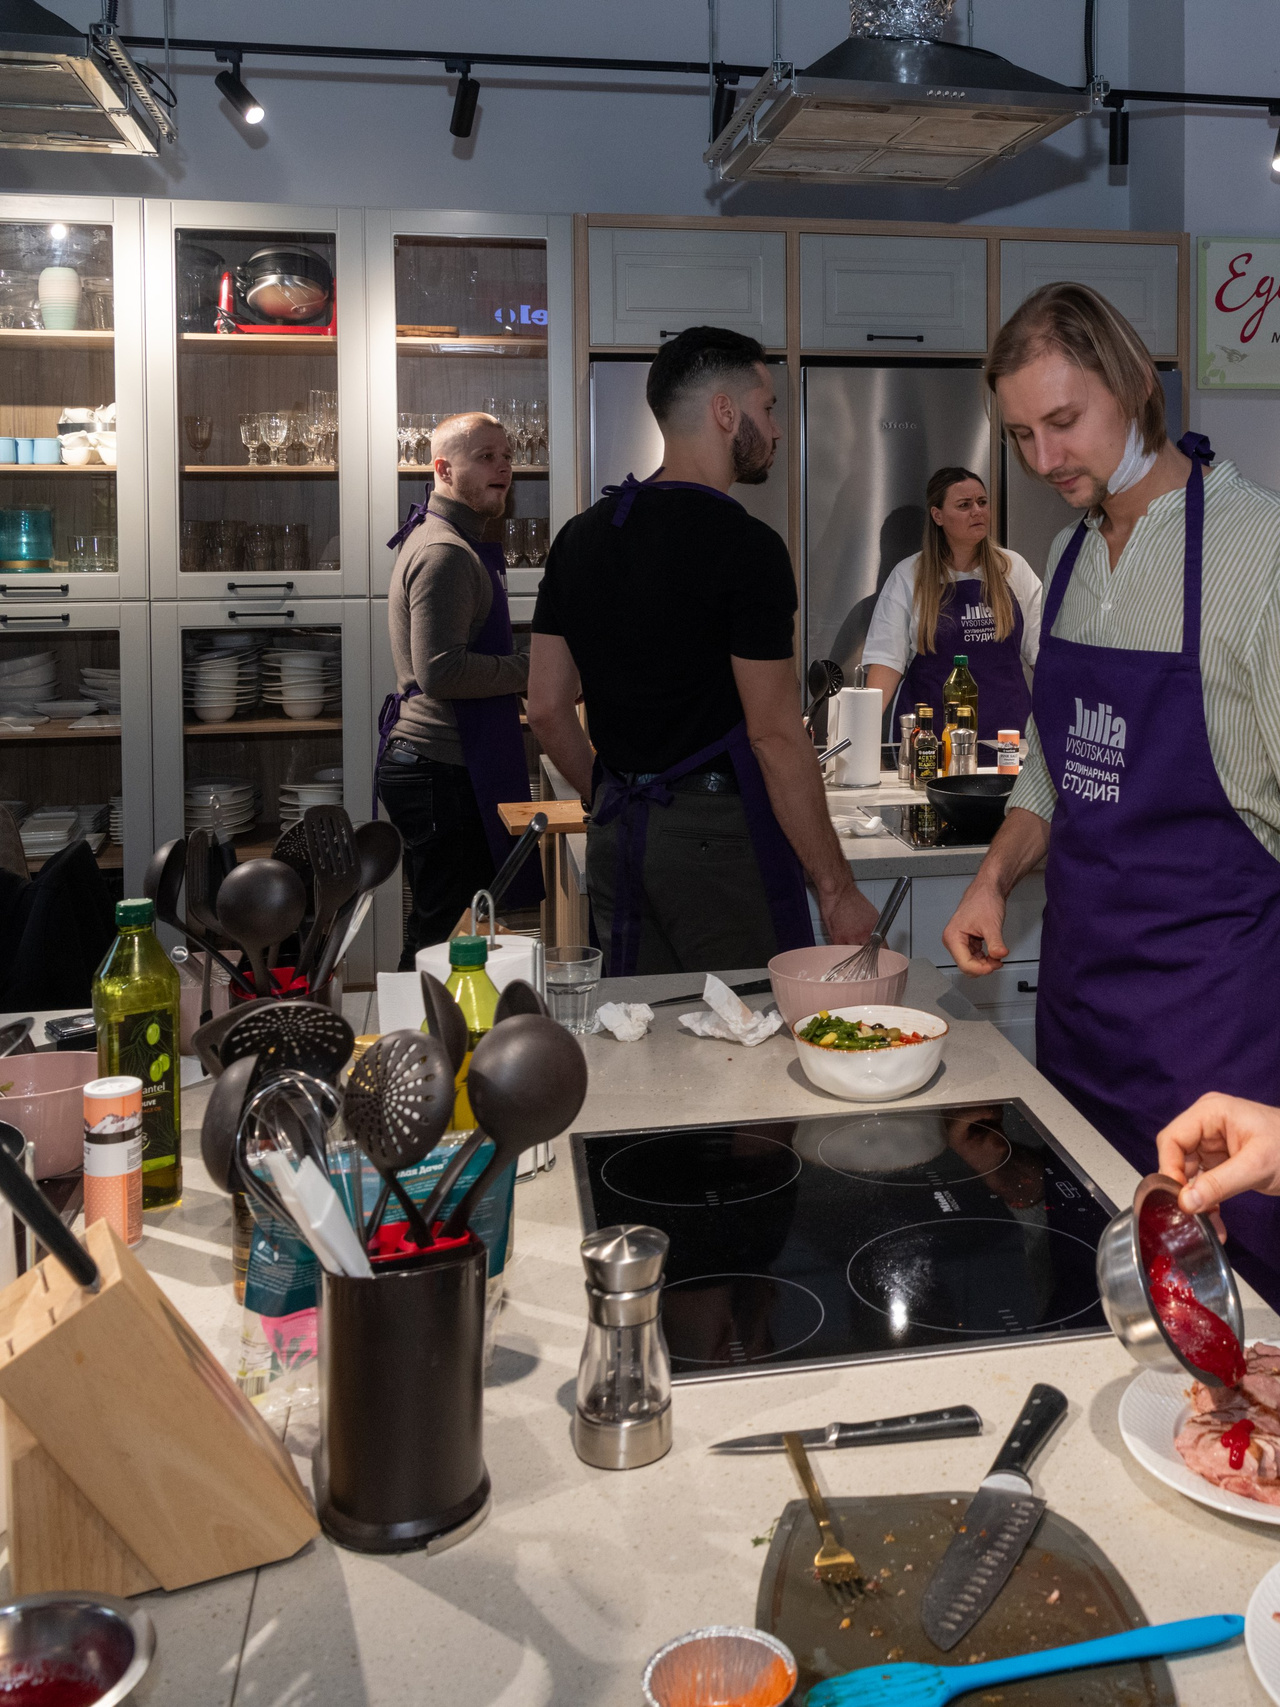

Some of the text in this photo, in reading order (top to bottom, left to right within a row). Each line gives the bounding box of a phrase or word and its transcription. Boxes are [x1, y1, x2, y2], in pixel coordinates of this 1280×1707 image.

[1068, 697, 1126, 750] Julia
[1065, 736, 1125, 768] VYSOTSKAYA
[1065, 759, 1120, 784] КУЛИНАРНАЯ
[1062, 772, 1120, 803] СТУДИЯ
[933, 1191, 953, 1213] Miele
